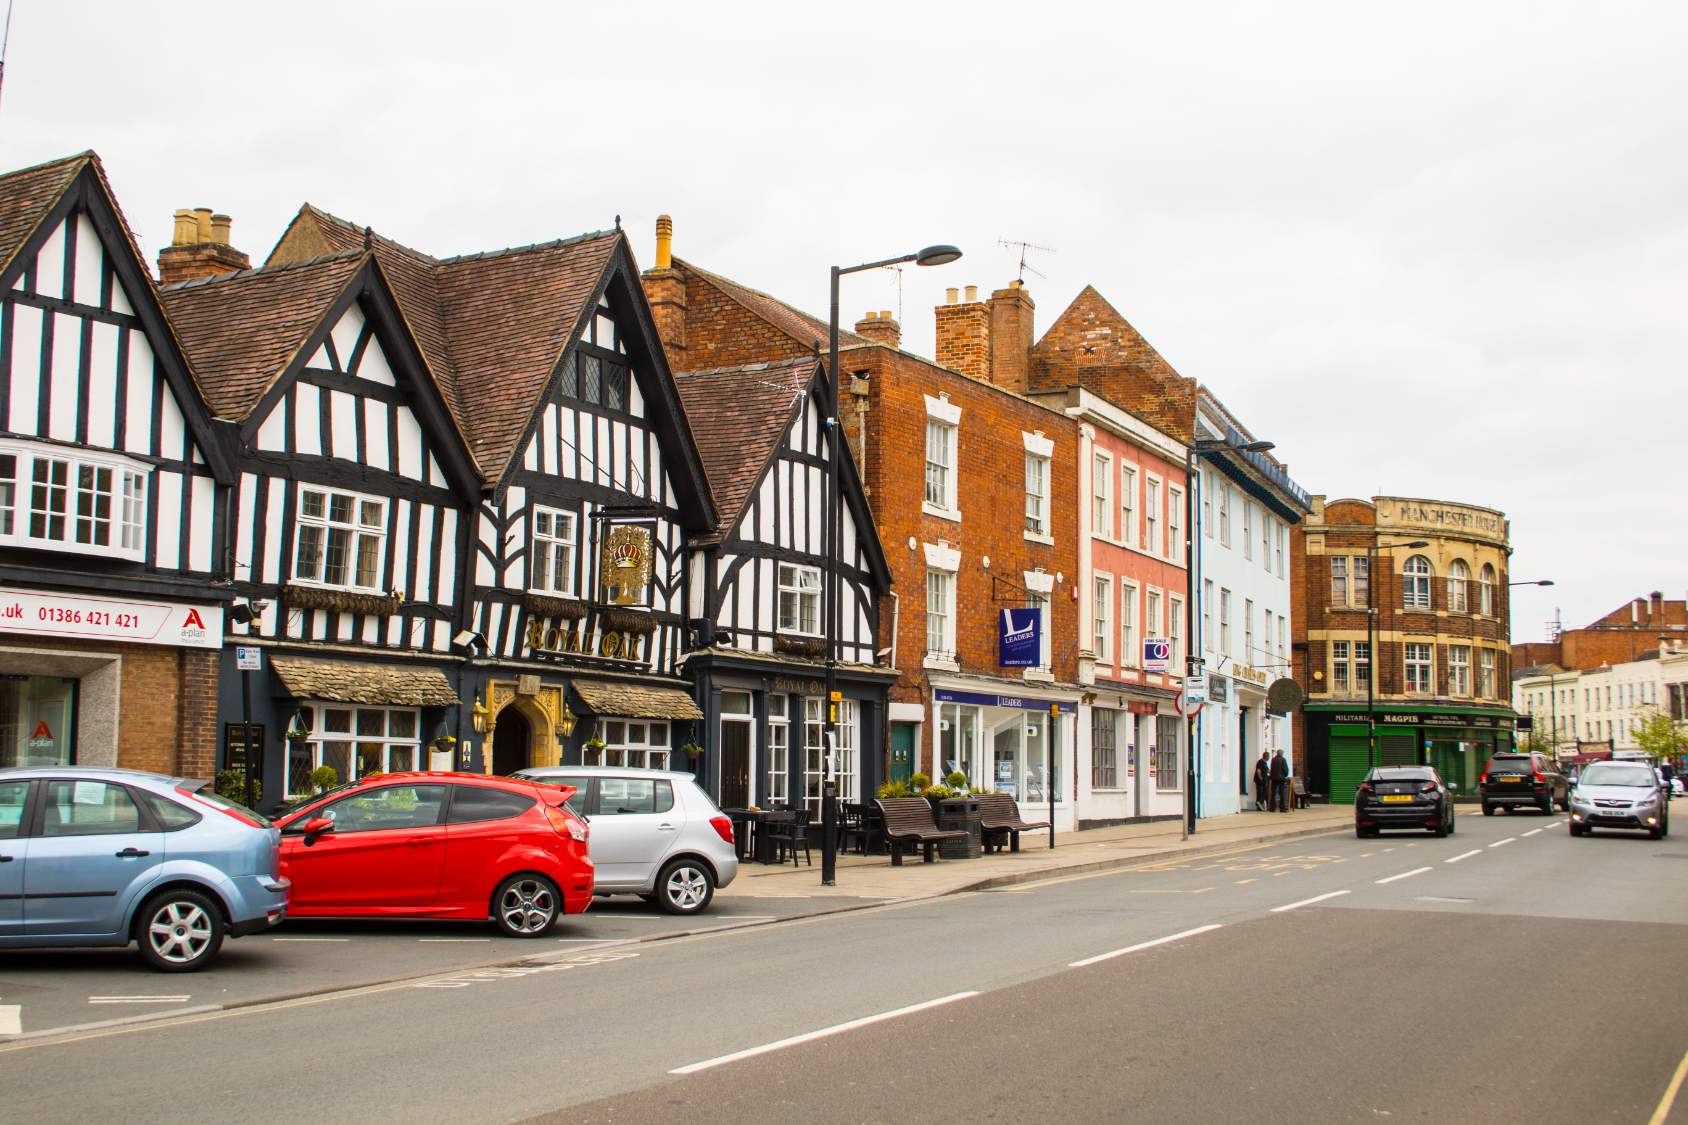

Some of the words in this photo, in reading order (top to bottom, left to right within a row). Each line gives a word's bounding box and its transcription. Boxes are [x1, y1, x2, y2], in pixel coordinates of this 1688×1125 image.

[38, 607, 81, 624] 01386
[86, 611, 110, 626] 421
[115, 613, 138, 628] 421
[524, 620, 594, 656] ROYAL
[601, 630, 642, 661] OAK
[1004, 631, 1034, 644] LEADERS
[1002, 697, 1022, 707] LEADERS
[1383, 714, 1419, 723] MAGPIE
